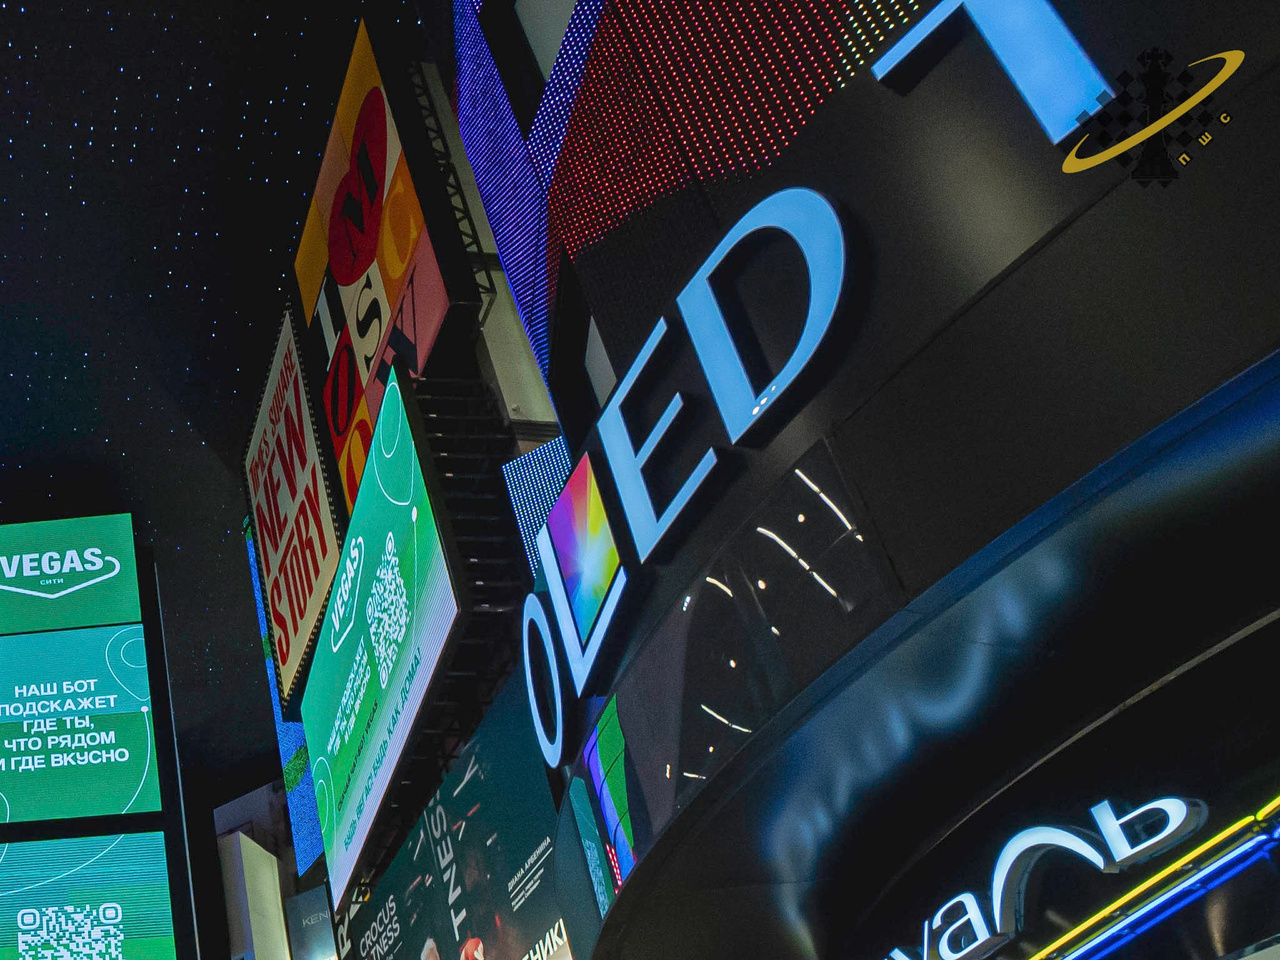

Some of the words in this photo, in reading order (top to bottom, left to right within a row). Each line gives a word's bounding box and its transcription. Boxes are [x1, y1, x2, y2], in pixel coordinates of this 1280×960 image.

[256, 371, 308, 579] NEW
[523, 186, 846, 769] OLED
[0, 547, 105, 579] VEGAS
[270, 461, 328, 667] STORY
[331, 537, 359, 633] VEGAS
[14, 682, 57, 698] НАШ
[62, 679, 98, 694] БОТ
[22, 717, 58, 734] ГДЕ
[62, 715, 95, 731] ТЫ,
[387, 709, 401, 742] КАК
[4, 737, 43, 753] ЧТО
[48, 731, 116, 750] РЯДОМ
[10, 756, 47, 773] ГДЕ
[51, 748, 130, 767] ВКУСНО
[360, 895, 396, 957] CROCUS
